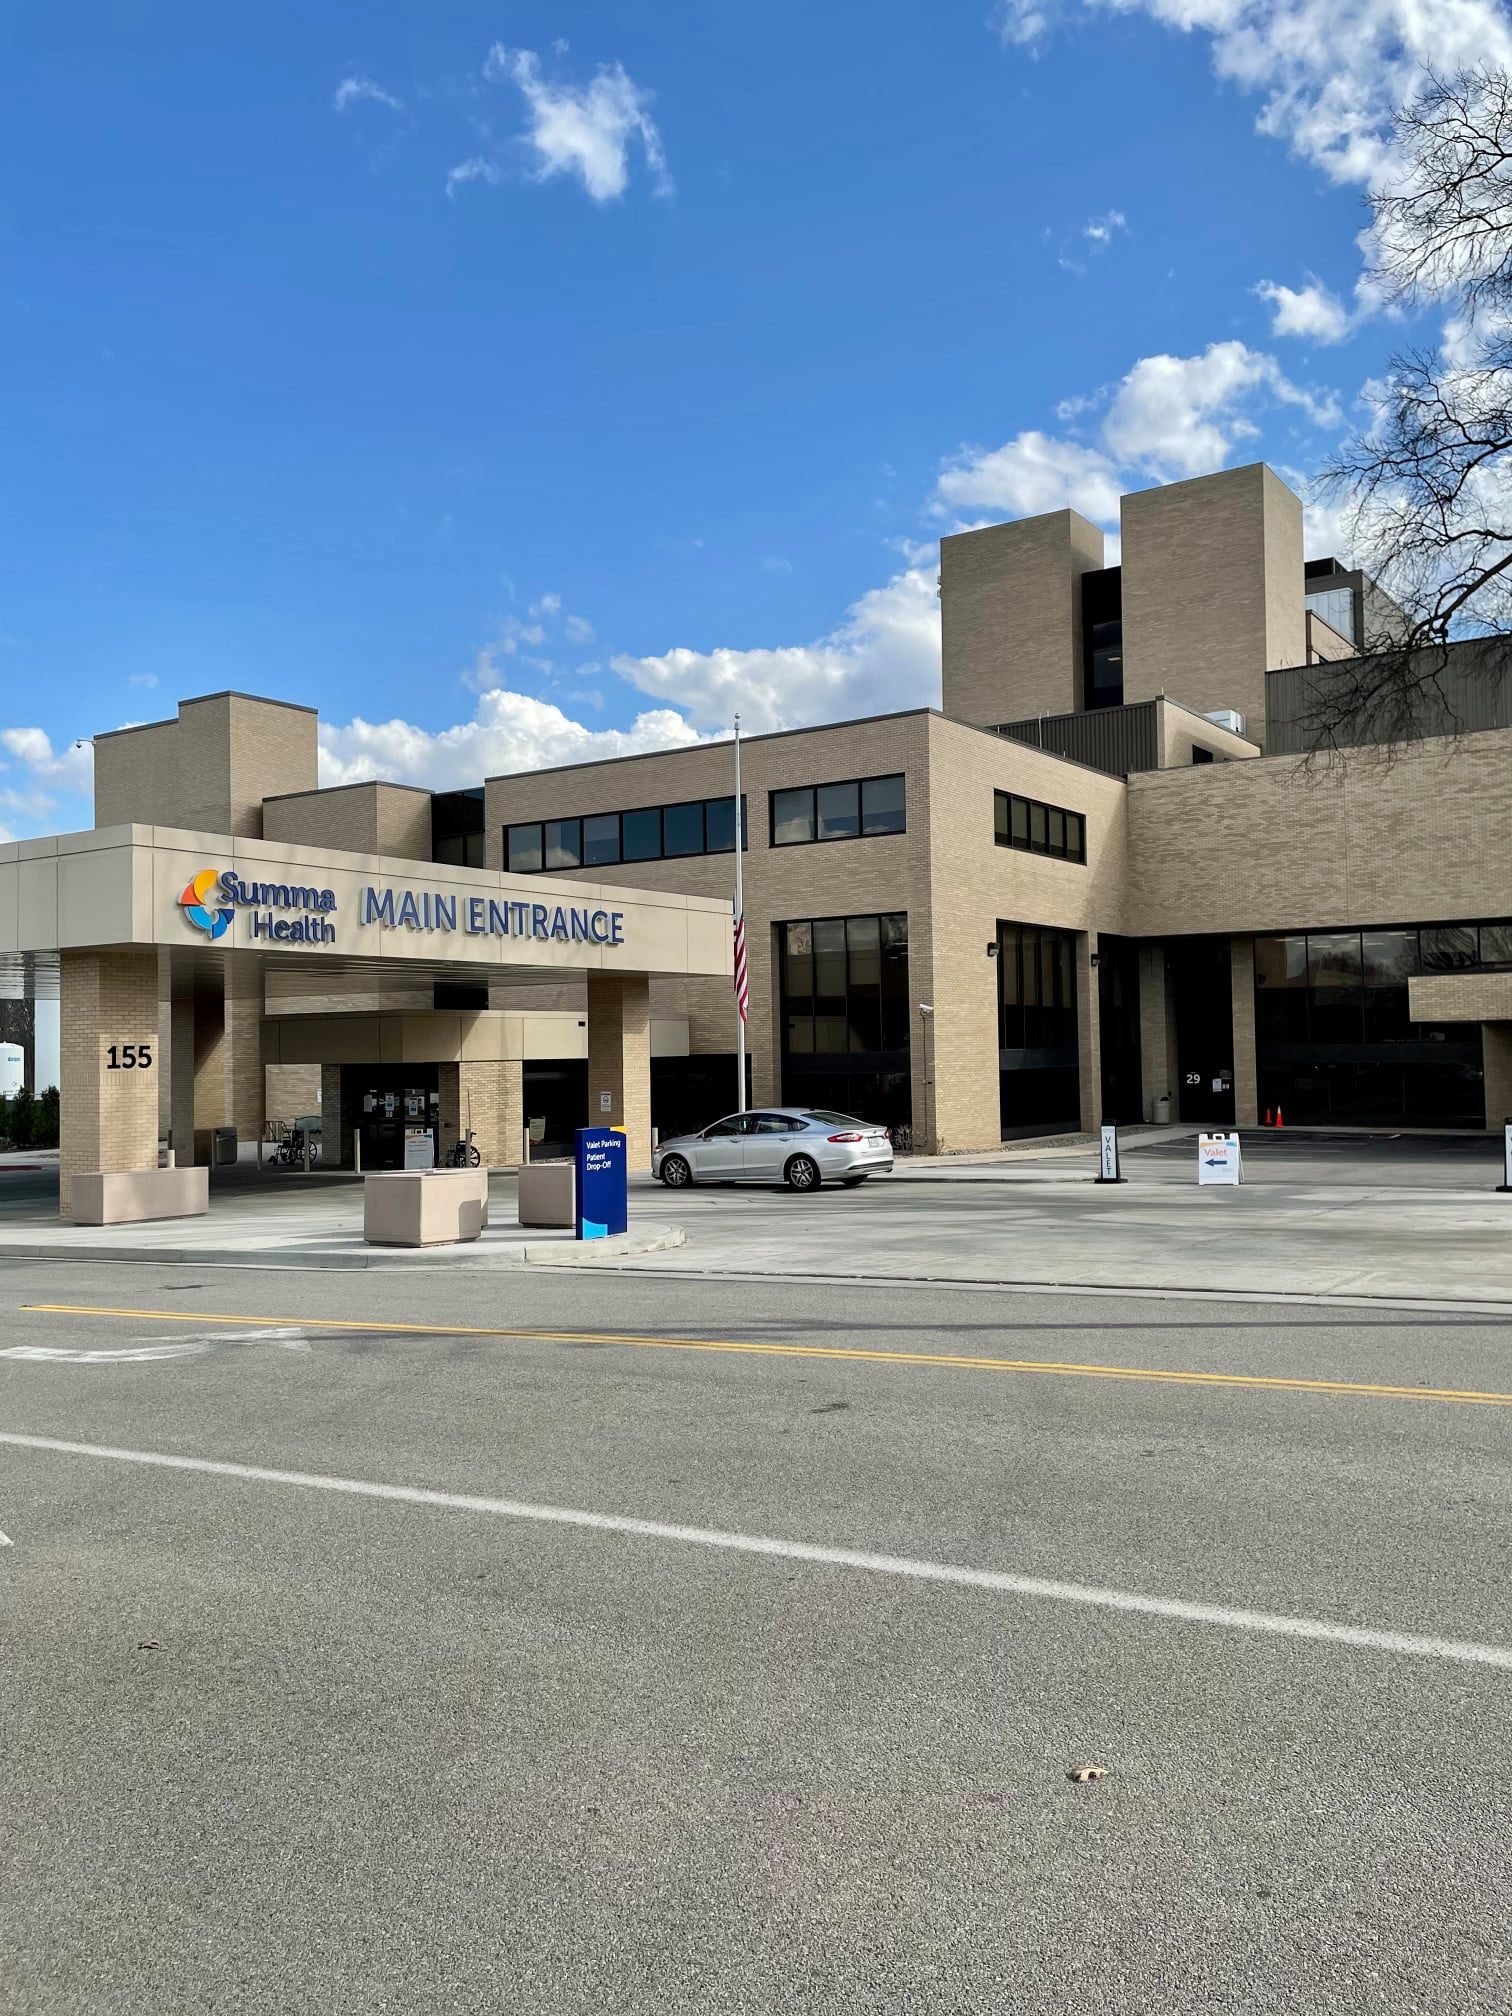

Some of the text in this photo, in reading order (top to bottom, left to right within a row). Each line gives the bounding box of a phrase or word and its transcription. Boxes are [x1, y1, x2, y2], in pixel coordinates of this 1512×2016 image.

[219, 871, 337, 911] Summa
[361, 886, 624, 944] MAIN ENTRANCE
[252, 911, 336, 943] Health
[107, 1045, 152, 1069] 155
[1186, 1074, 1200, 1084] 29
[586, 1139, 621, 1149] Valet Parking
[586, 1153, 606, 1162] Patient
[1204, 1148, 1227, 1157] Valet
[586, 1161, 612, 1171] Drop-Off
